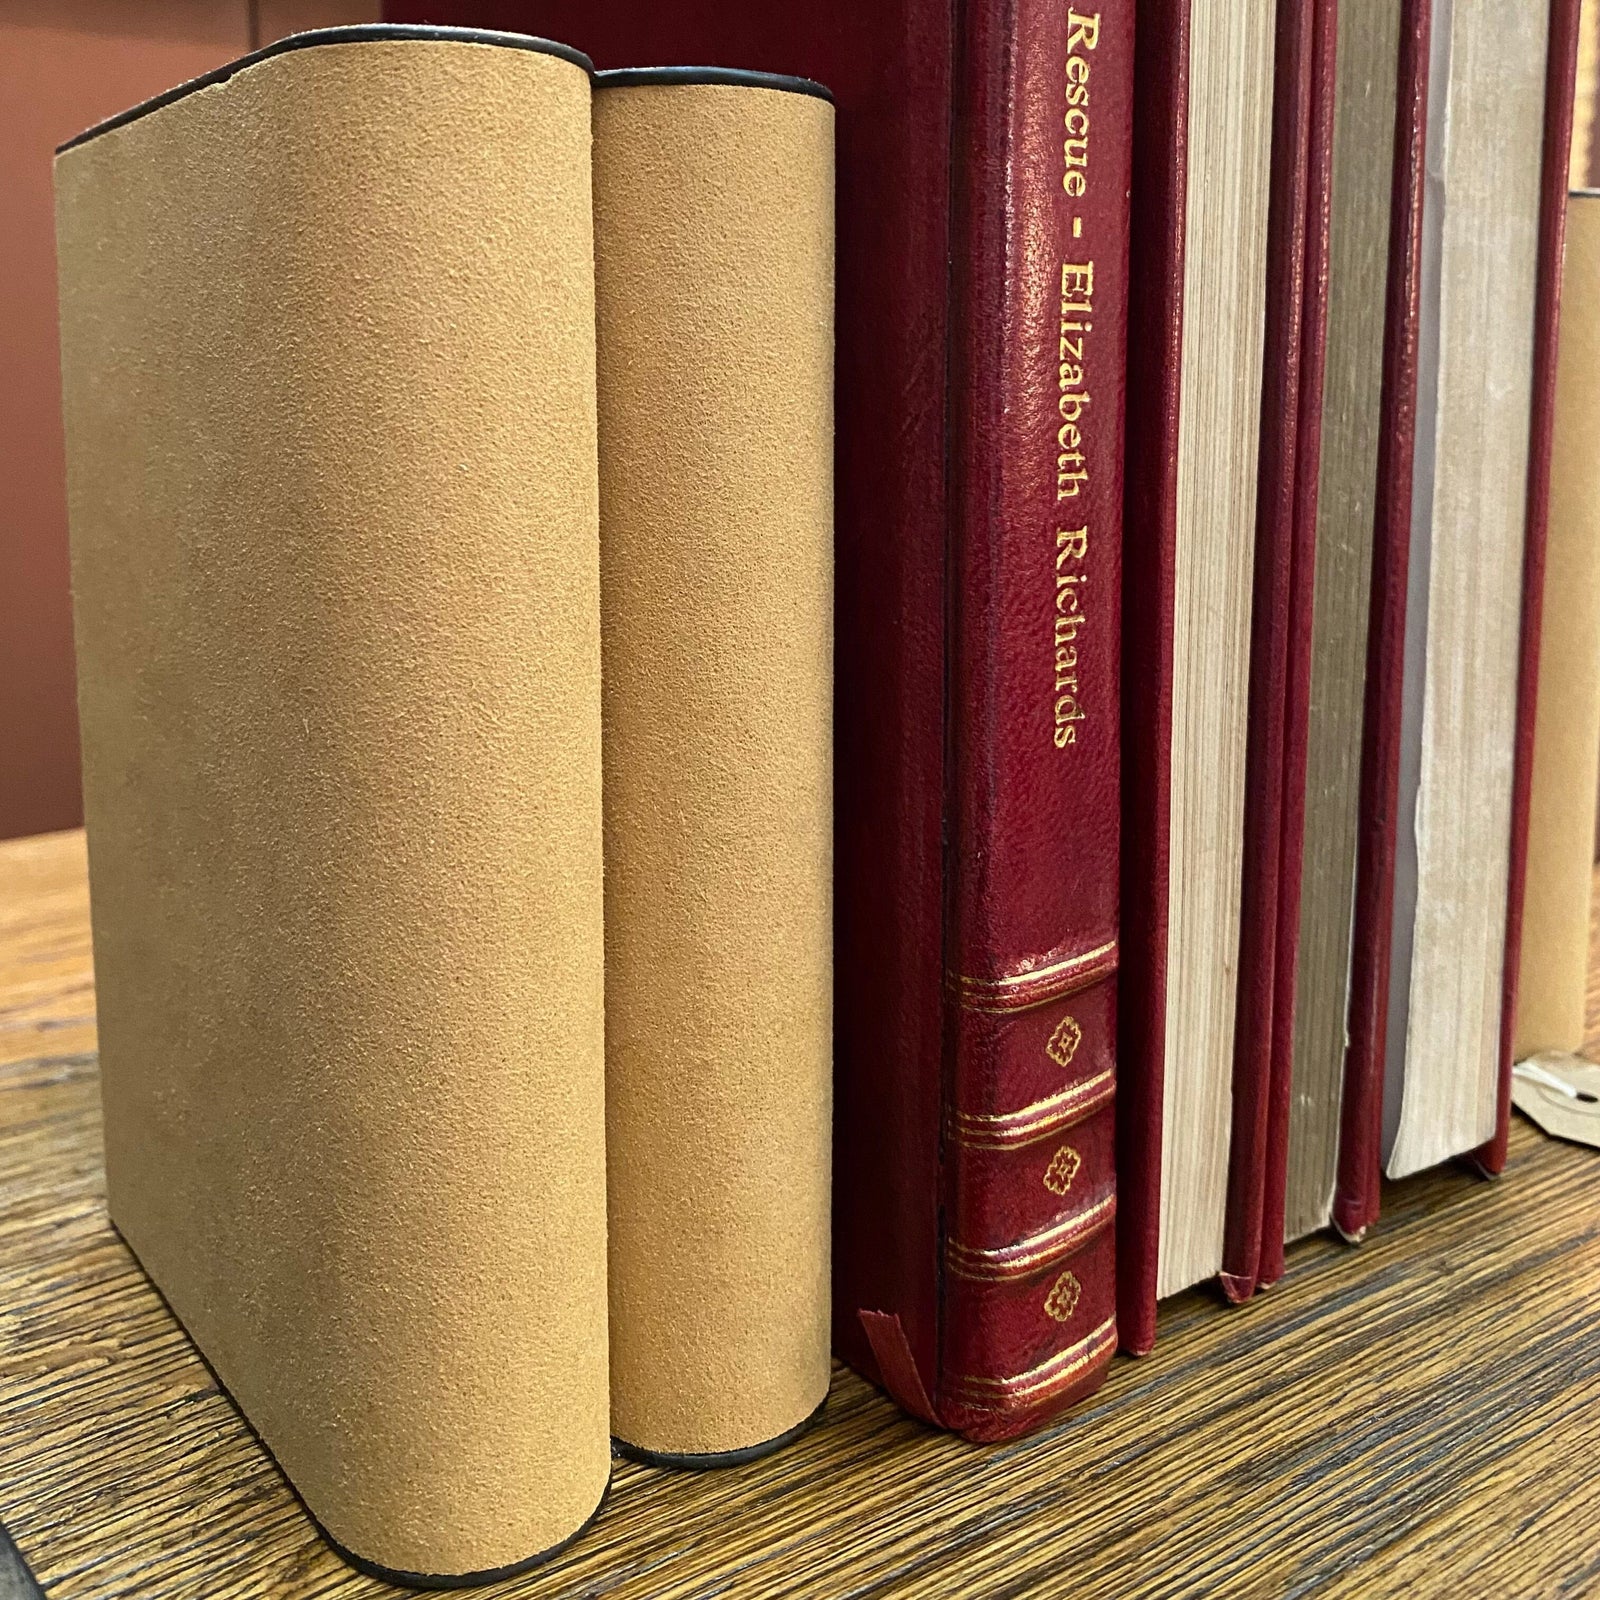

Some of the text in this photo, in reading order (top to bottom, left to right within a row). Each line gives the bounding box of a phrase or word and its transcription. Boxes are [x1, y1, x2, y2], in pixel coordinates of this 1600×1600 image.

[1053, 6, 1100, 749] Rescue - Elizabeth Richards
